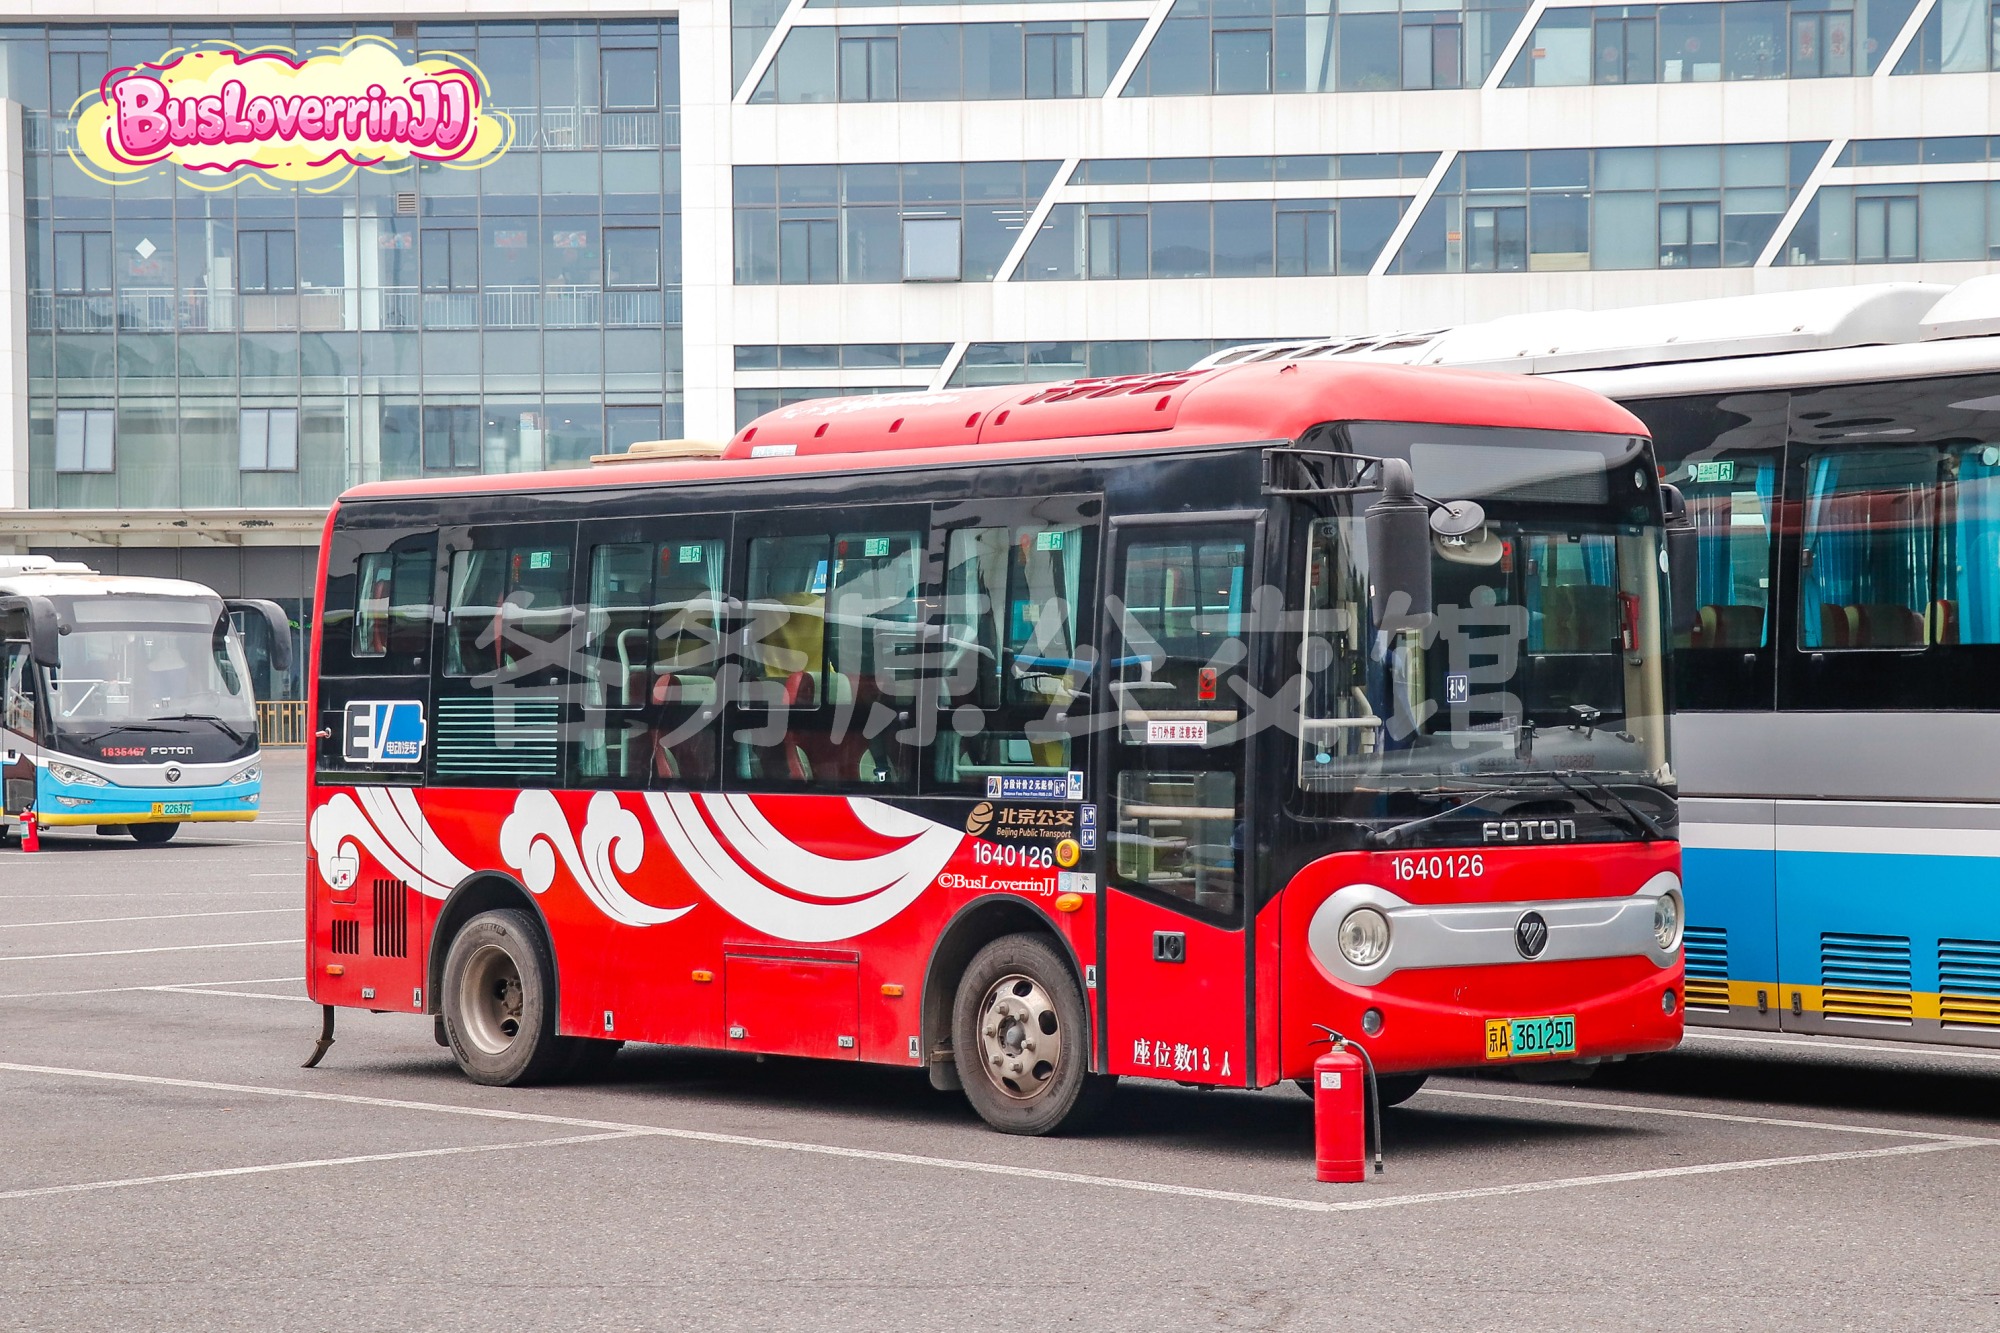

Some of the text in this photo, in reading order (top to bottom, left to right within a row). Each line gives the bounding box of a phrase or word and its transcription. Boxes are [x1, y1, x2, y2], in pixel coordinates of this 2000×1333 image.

[150, 746, 194, 755] FOTON
[386, 741, 417, 755] 电动汽车
[998, 808, 1075, 826] 北京公交
[996, 827, 1072, 840] Beijing Public Transport
[1482, 819, 1576, 842] FOTON
[972, 841, 1053, 869] 1640126
[1391, 854, 1484, 881] 1640126
